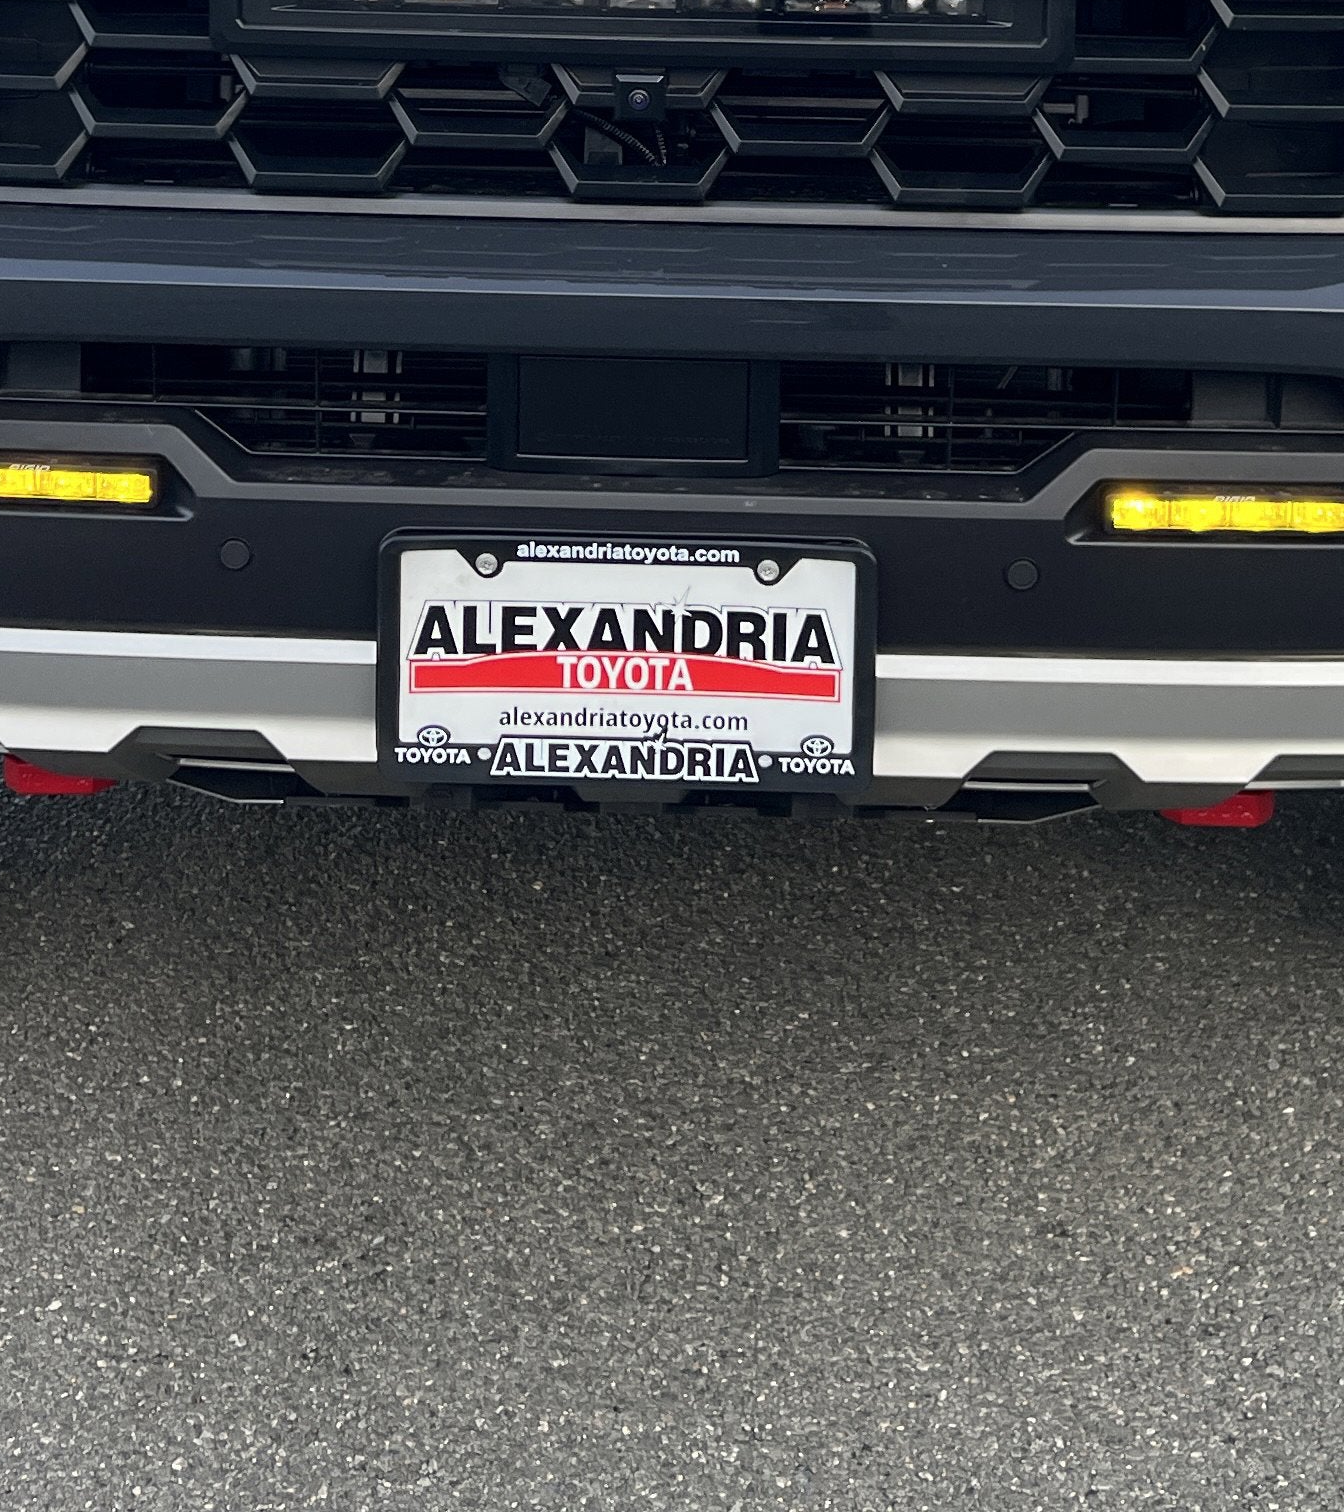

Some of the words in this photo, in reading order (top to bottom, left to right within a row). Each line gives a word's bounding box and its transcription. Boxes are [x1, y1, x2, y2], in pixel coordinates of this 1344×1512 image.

[516, 540, 740, 565] alexandriatoyota.com
[411, 603, 837, 666] ALEXANDRIA
[556, 655, 694, 691] TOYOTA
[498, 706, 749, 733] alexandriatoyota.com
[394, 746, 472, 765] TOYOTA
[493, 741, 757, 780] ALEXANDRIA
[777, 756, 856, 776] TOYOTA
